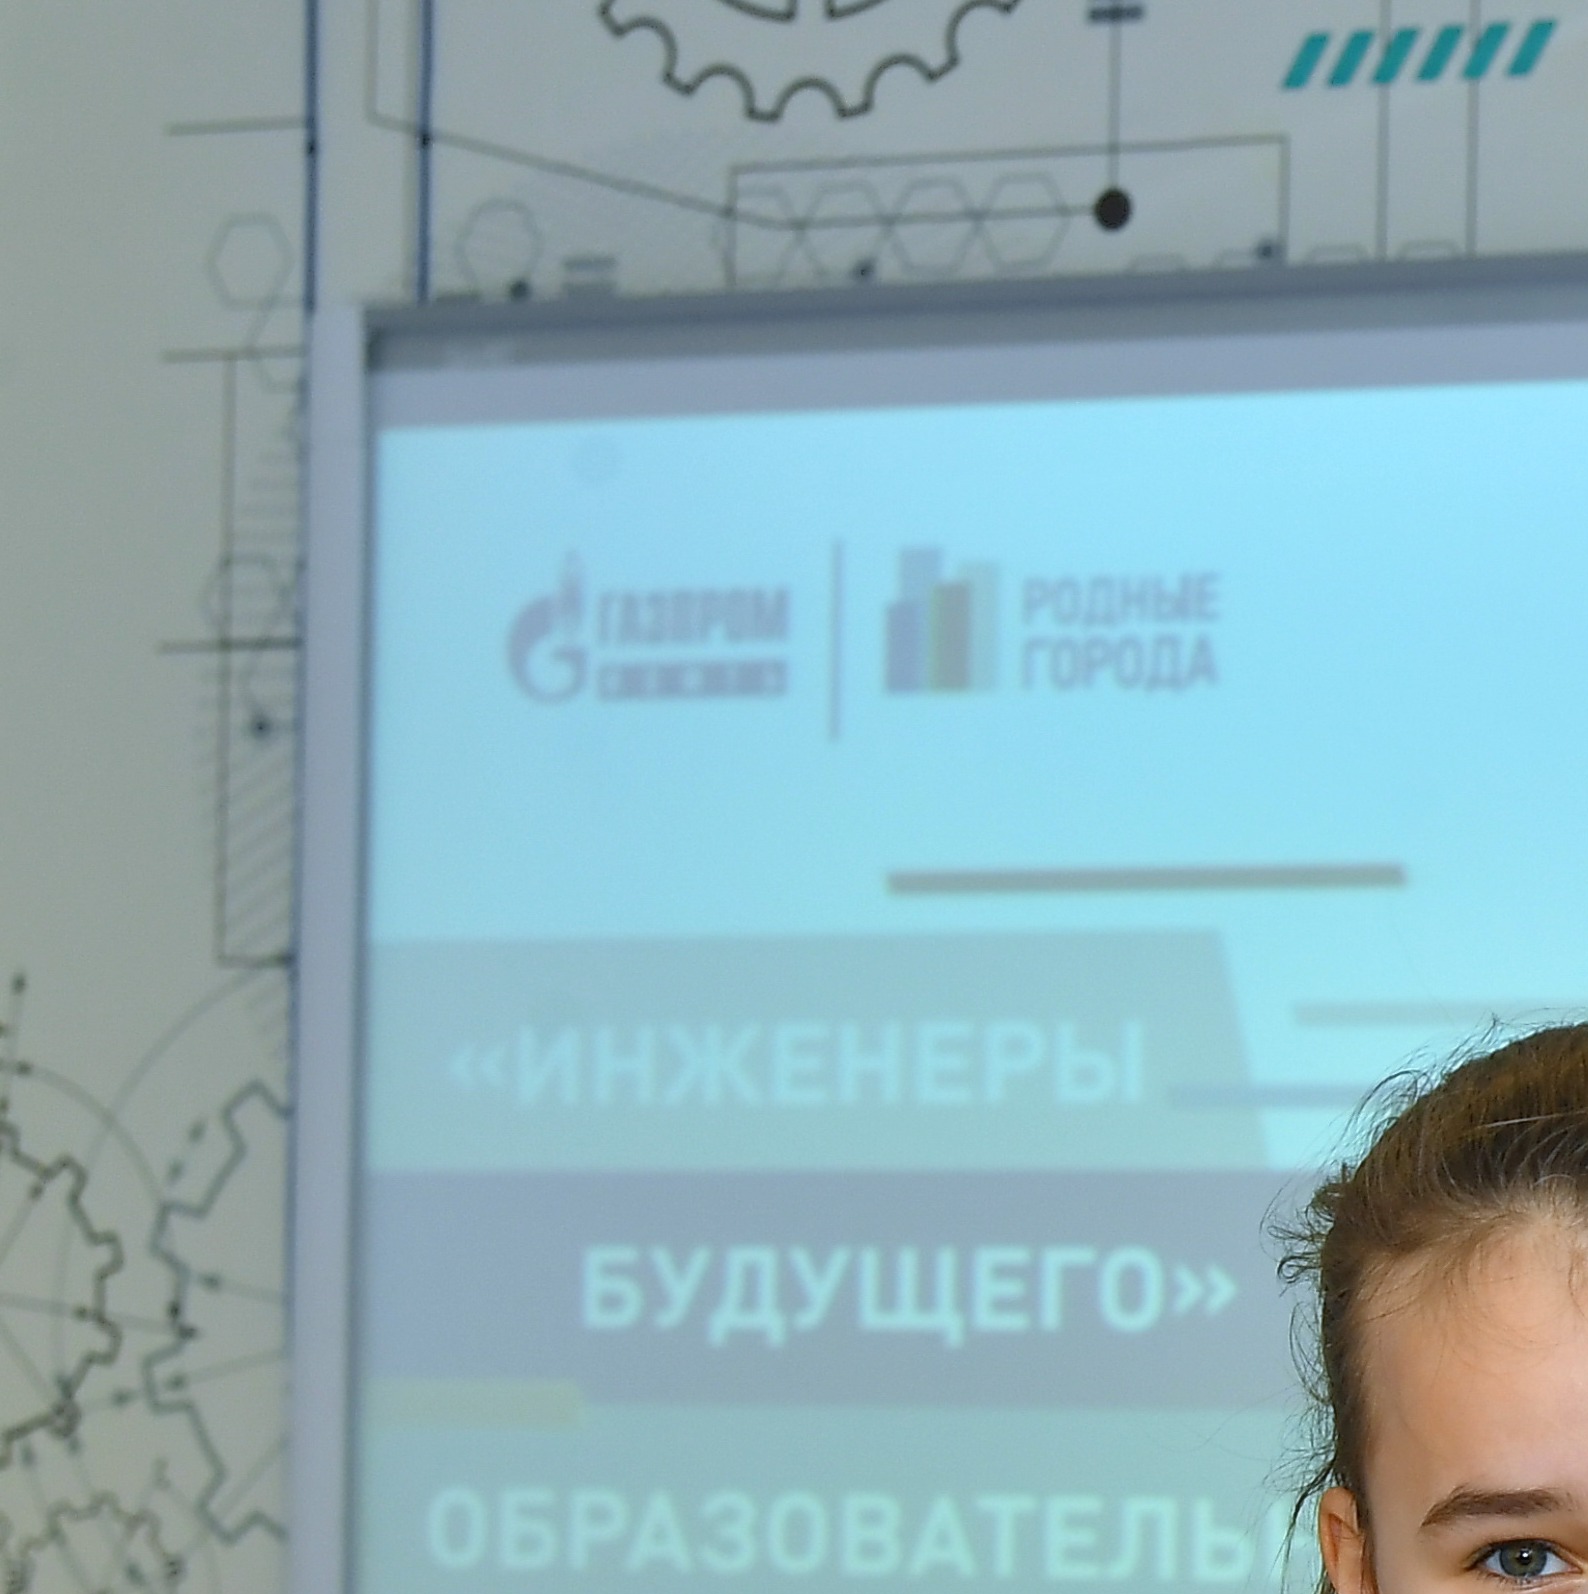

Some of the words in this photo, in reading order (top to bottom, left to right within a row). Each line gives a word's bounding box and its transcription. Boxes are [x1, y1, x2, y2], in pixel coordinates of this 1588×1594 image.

[1022, 571, 1222, 628] РОДНЫЕ
[1022, 634, 1221, 692] ГОРОДА
[452, 1019, 1144, 1107] «ИНЖЕНЕРЫ
[582, 1244, 1237, 1349] БУДУЩЕГО»
